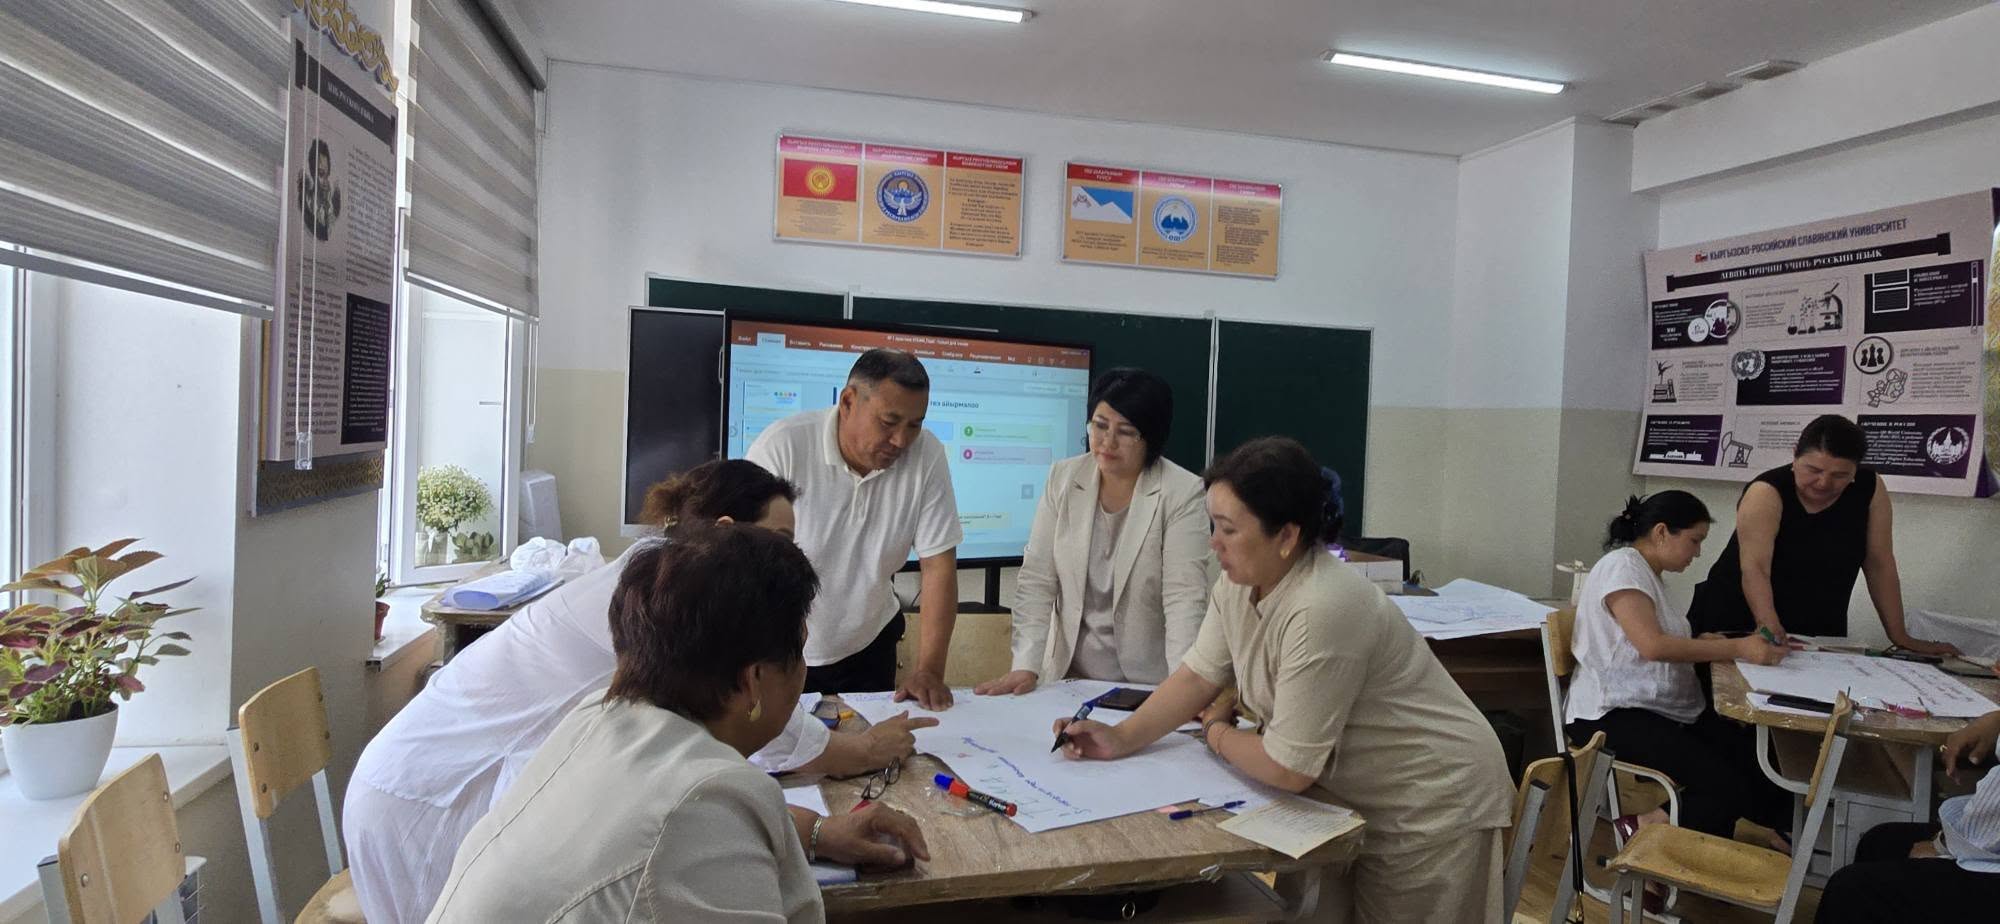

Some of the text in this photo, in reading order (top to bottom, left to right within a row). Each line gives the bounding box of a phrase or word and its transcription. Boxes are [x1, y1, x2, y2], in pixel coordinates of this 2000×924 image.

[1710, 218, 1907, 260] КЫРГЫЗСКО-РОССИЙСКИЙ СЛАВЯНСКИЙ УНИВЕРСИТЕТ
[1720, 249, 1883, 280] ДЕВЯТЬ ПРИЧИН УЧИТЬ РУССКИЙ ЯЗЫК
